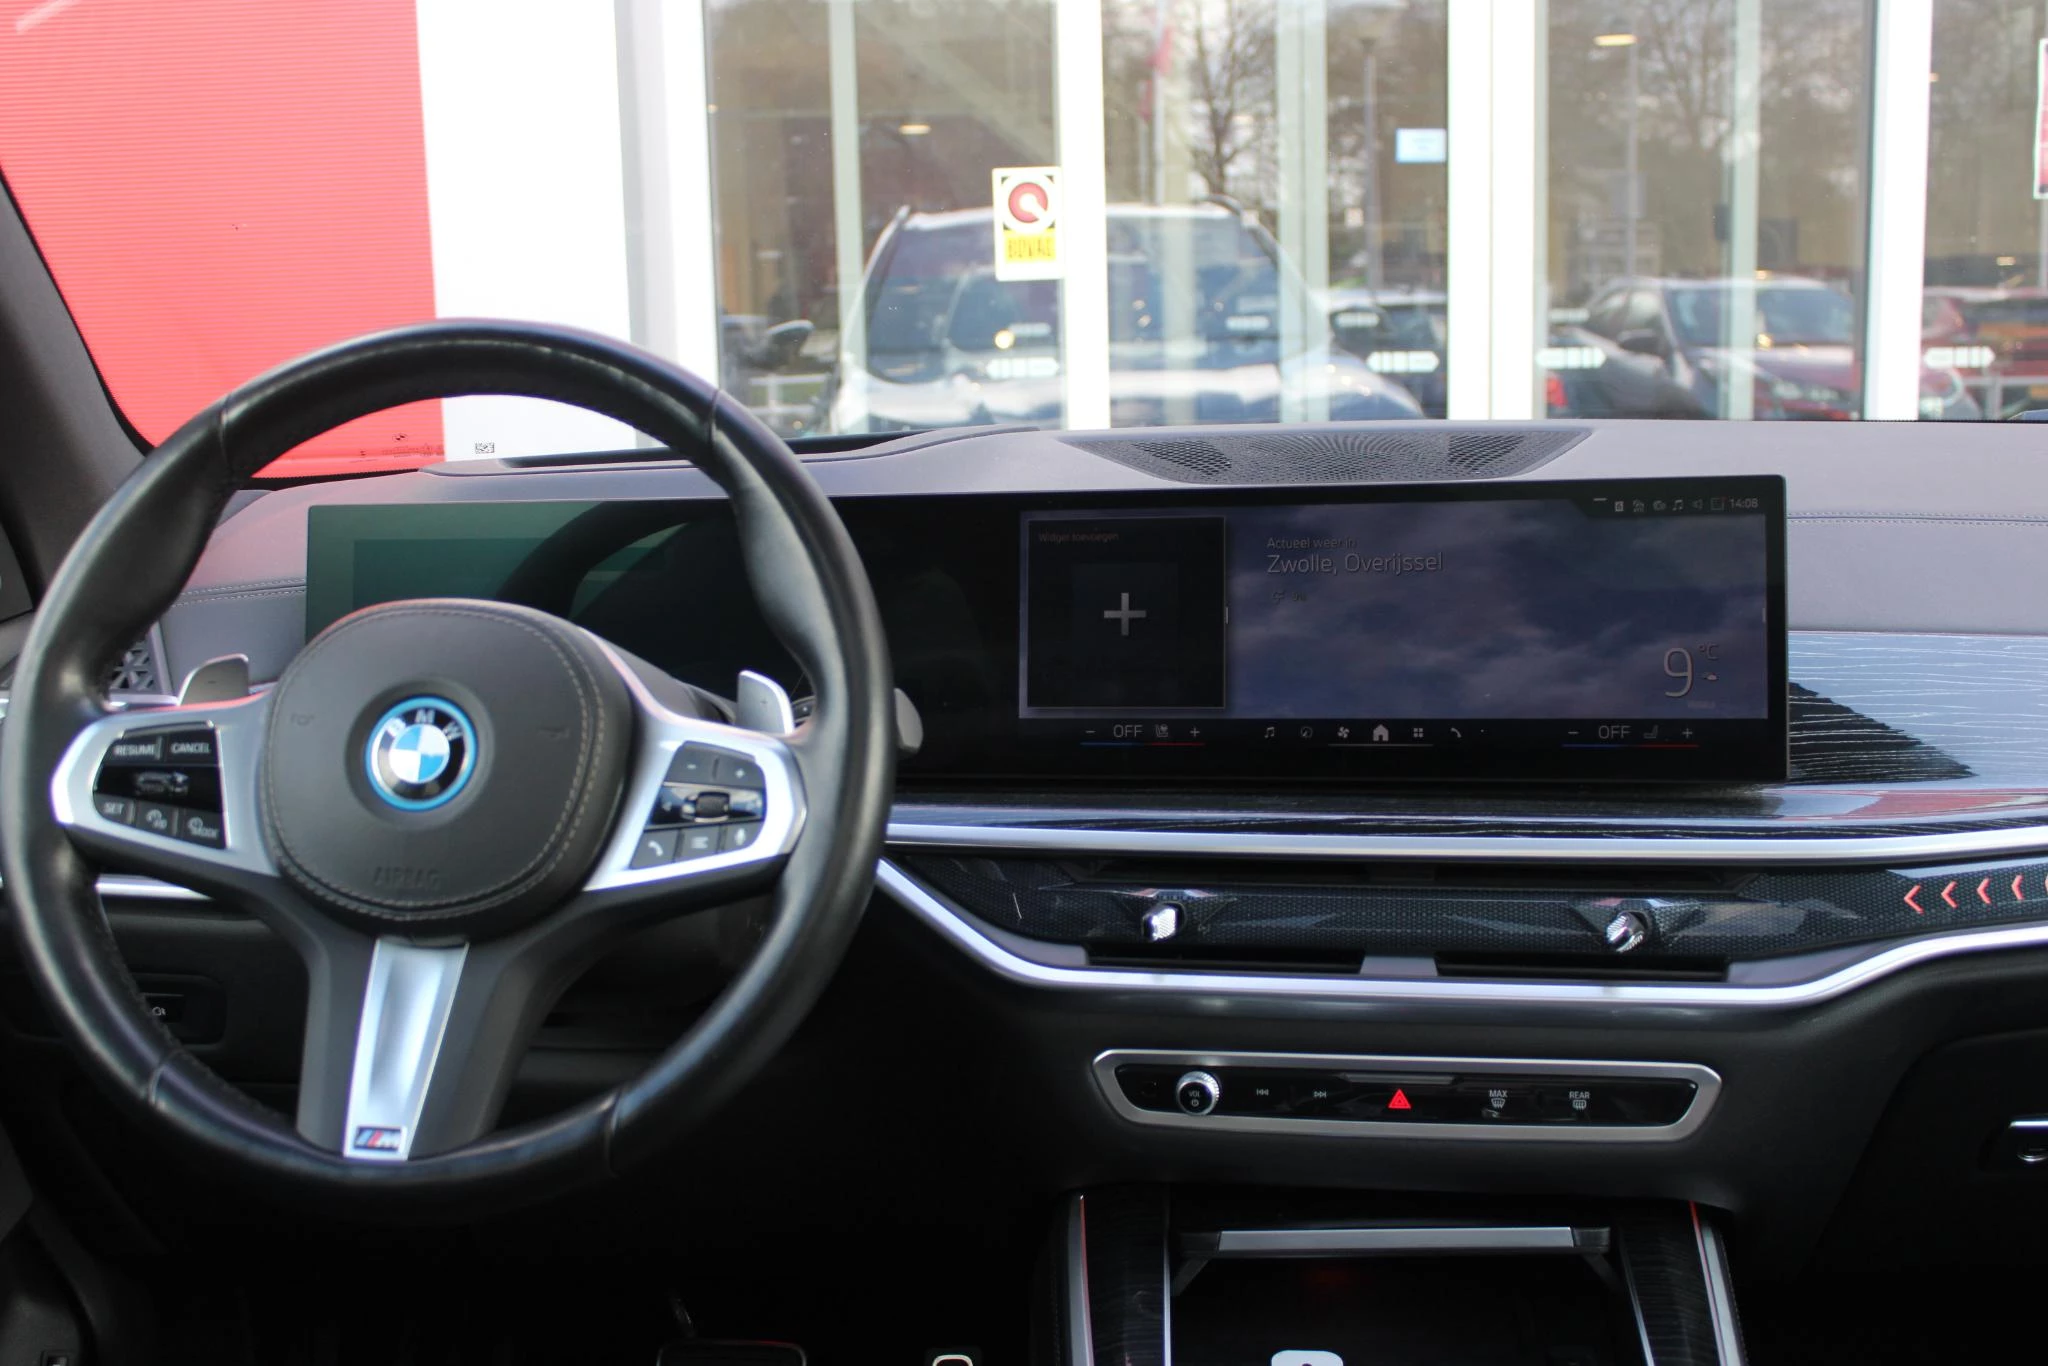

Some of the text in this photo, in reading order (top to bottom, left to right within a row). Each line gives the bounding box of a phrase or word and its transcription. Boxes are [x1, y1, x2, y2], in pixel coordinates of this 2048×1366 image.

[1266, 537, 1310, 549] Actueel
[1266, 552, 1443, 575] Zwolle, Overijssel
[1664, 647, 1693, 697] 9
[385, 708, 462, 741] BMW
[1113, 724, 1143, 738] OFF
[1598, 725, 1631, 739] OFF
[112, 743, 157, 756] RESUME
[170, 742, 210, 754] CANCEL
[103, 802, 125, 815] SET
[1489, 1089, 1508, 1099] MAX
[1569, 1091, 1591, 1100] REAR
